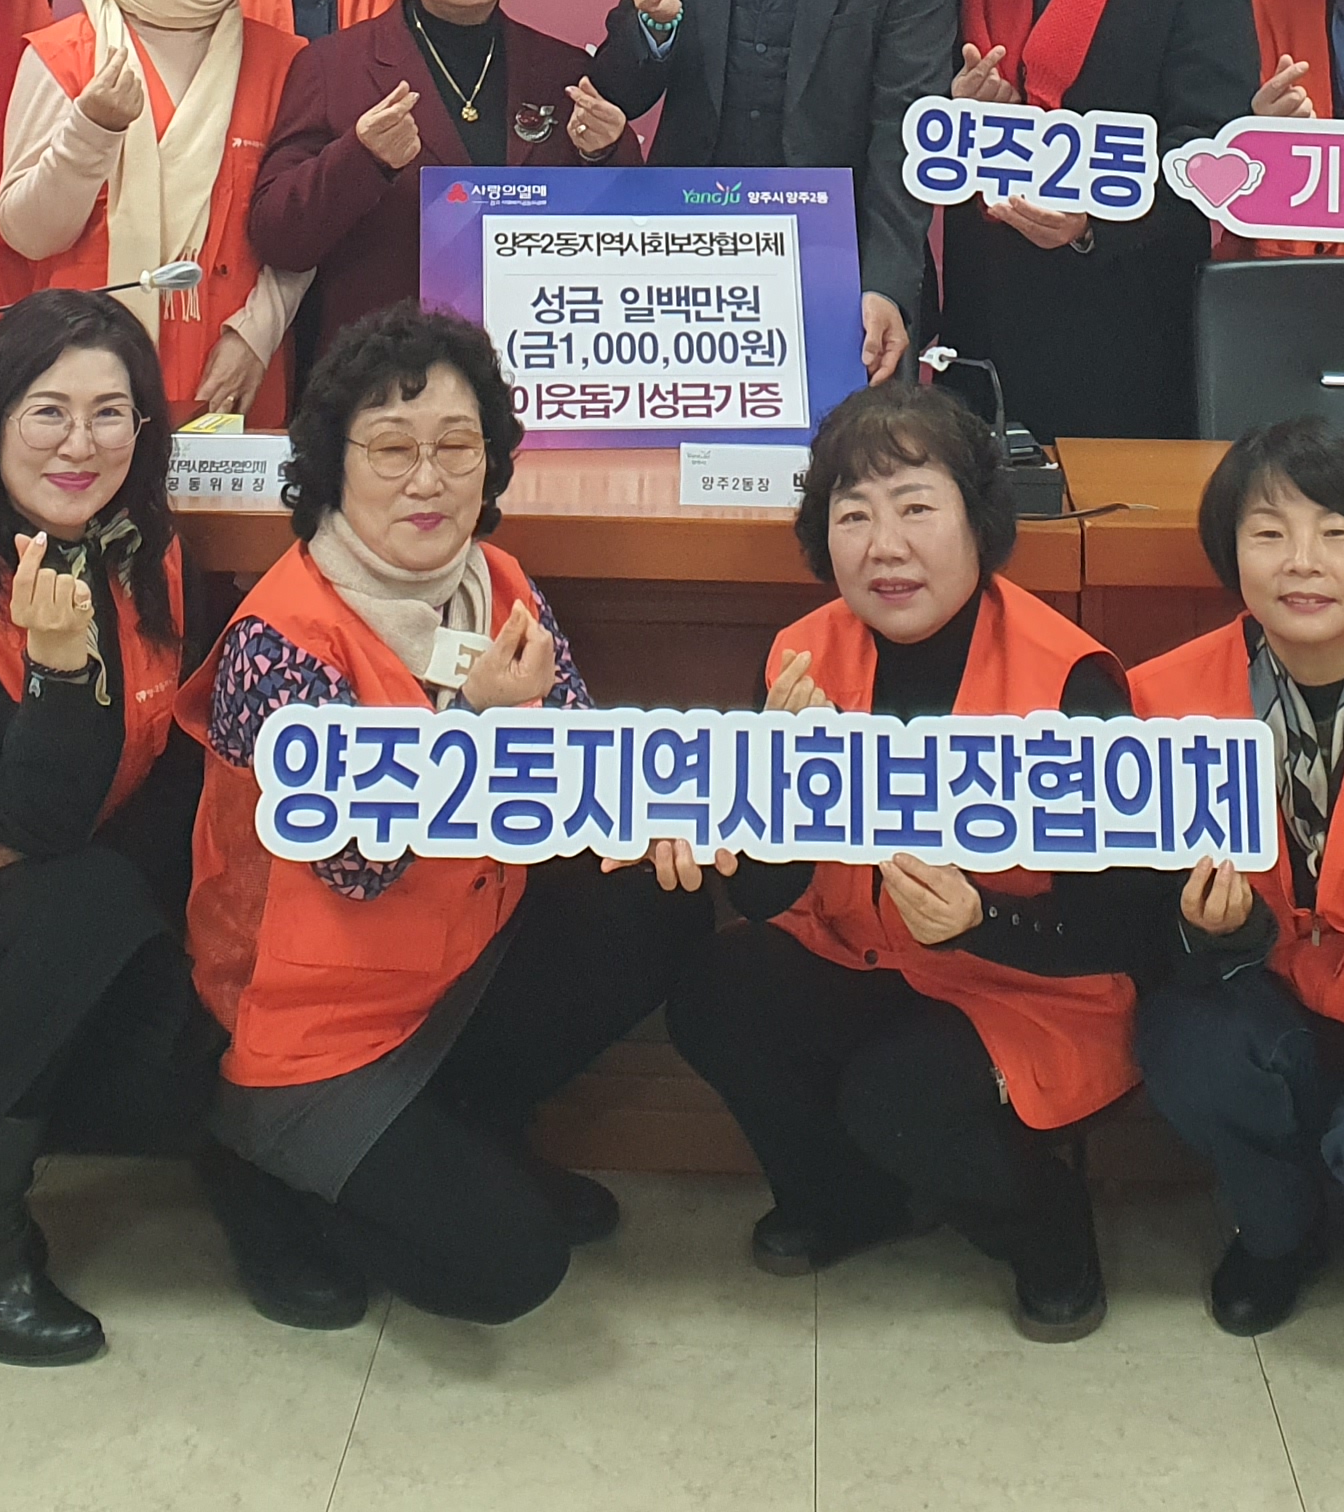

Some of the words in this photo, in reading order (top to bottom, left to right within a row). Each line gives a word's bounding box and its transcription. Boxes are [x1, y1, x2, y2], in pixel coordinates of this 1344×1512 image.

[916, 108, 1147, 208] 양주2동
[470, 184, 548, 200] 사랑의열매
[494, 231, 785, 257] 양주2동지역사회보장협의체
[530, 285, 604, 324] 성금
[619, 285, 762, 324] 일백만원
[506, 328, 788, 371] (금1,000,000원)
[511, 382, 784, 420] 이웃돕기성금기증
[272, 722, 1259, 856] 양주2동지역사회보장협의체
